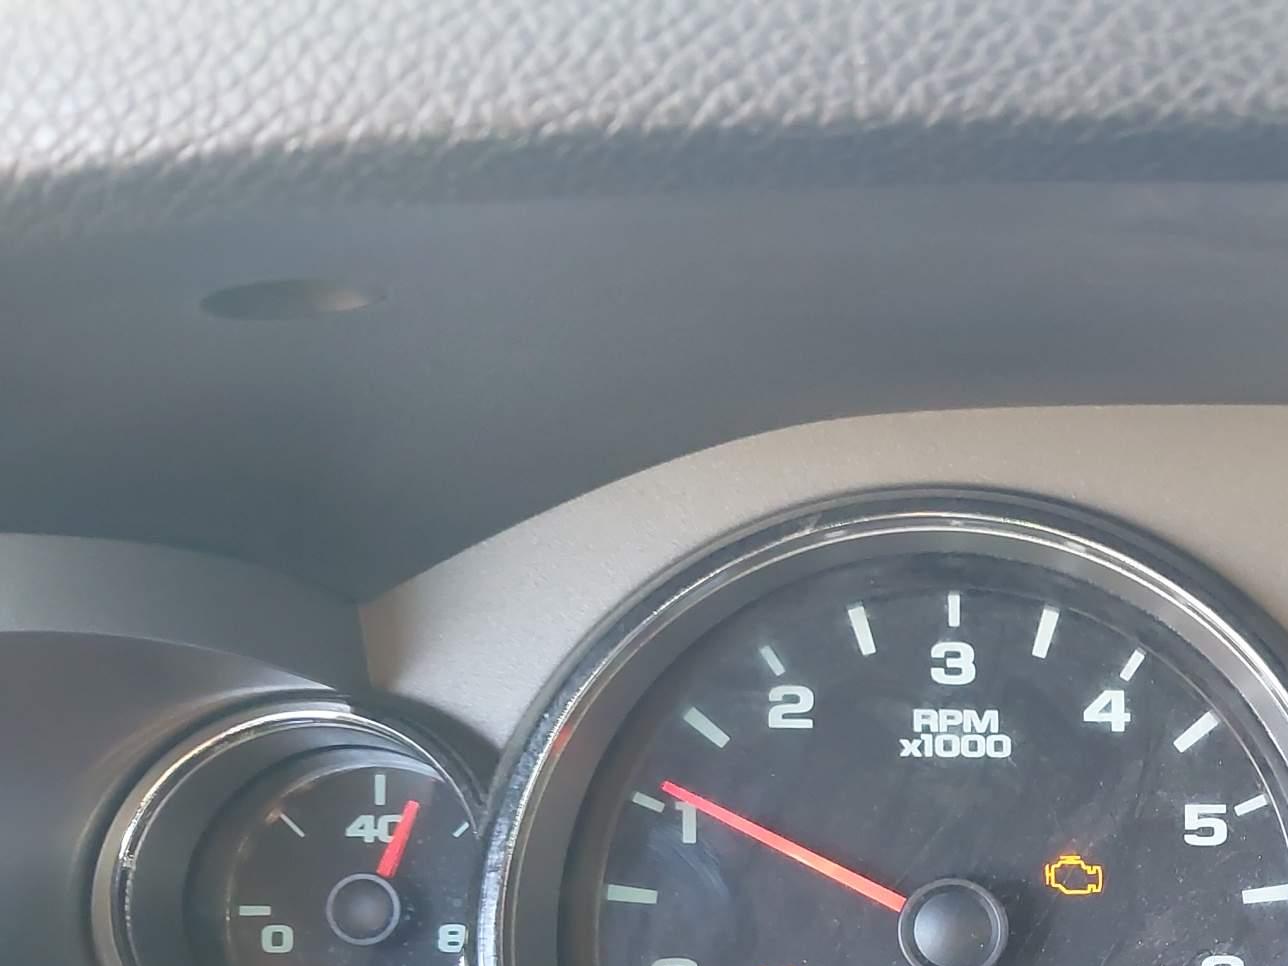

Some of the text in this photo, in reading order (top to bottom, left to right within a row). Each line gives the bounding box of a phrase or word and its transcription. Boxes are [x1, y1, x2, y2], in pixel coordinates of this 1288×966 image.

[930, 642, 976, 685] 3
[768, 685, 814, 730] 2
[913, 709, 999, 733] RPM
[1082, 689, 1131, 733] 4
[900, 734, 1012, 759] x1000
[675, 801, 697, 844] 1
[1183, 803, 1228, 847] 5
[261, 924, 295, 954] 0
